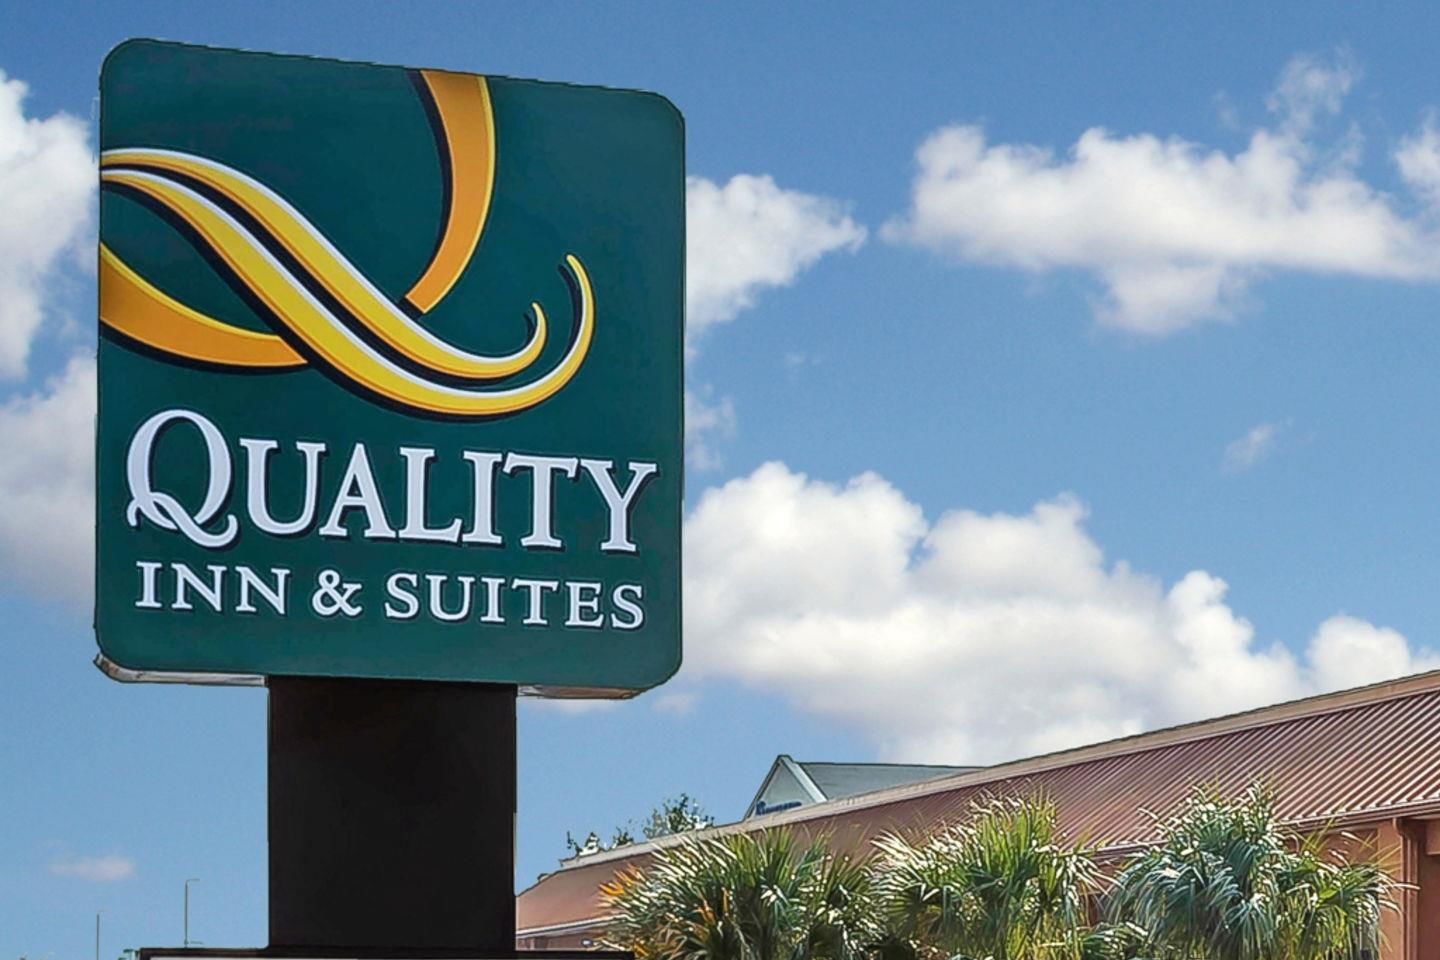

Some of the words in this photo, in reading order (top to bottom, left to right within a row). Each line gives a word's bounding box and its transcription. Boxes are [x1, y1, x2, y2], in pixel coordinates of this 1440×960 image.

[127, 409, 657, 552] QUALITY
[135, 561, 290, 614] INN
[311, 570, 363, 616] &
[384, 573, 644, 629] SUITES
